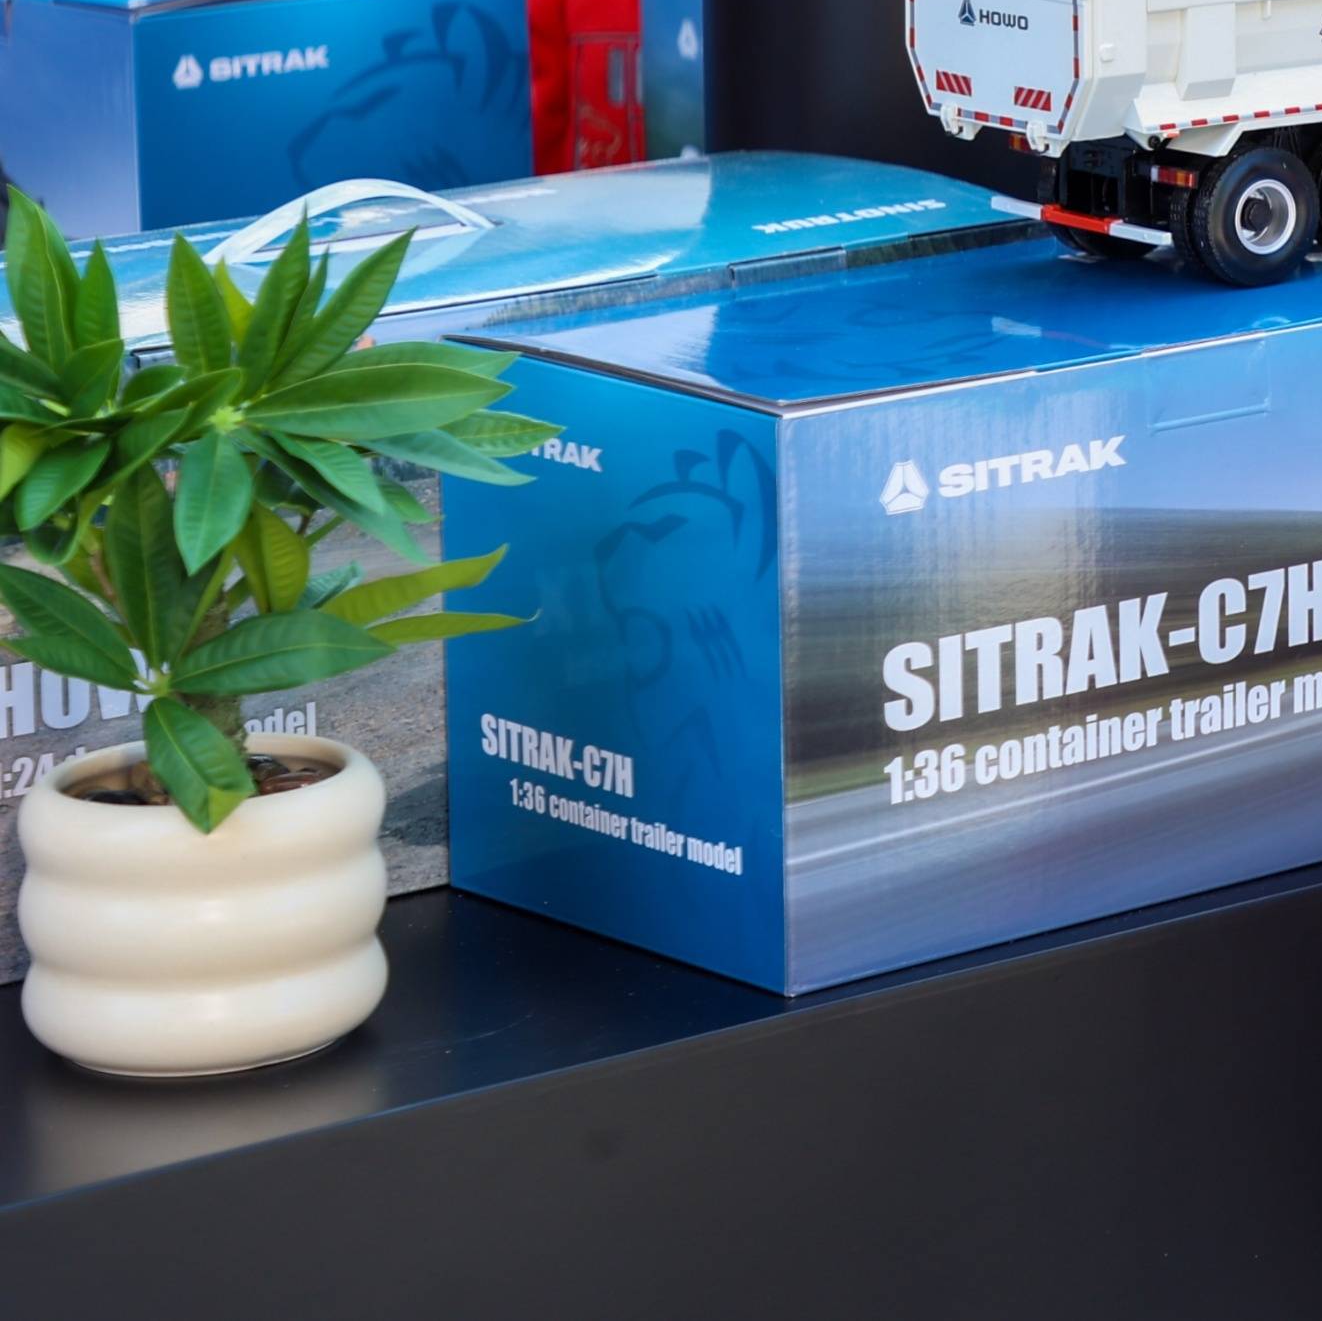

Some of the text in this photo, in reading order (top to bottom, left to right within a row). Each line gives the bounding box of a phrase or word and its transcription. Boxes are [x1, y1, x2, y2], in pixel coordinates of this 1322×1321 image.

[978, 8, 1029, 31] HOWO
[209, 44, 329, 82] SITRAK
[938, 434, 1127, 499] SITRAK
[481, 713, 635, 799] SITRAK-C7H
[883, 742, 966, 806] 1:36
[974, 706, 1163, 786] container
[1170, 676, 1286, 741] trailer
[509, 778, 743, 877] 1:36 container trailer model
